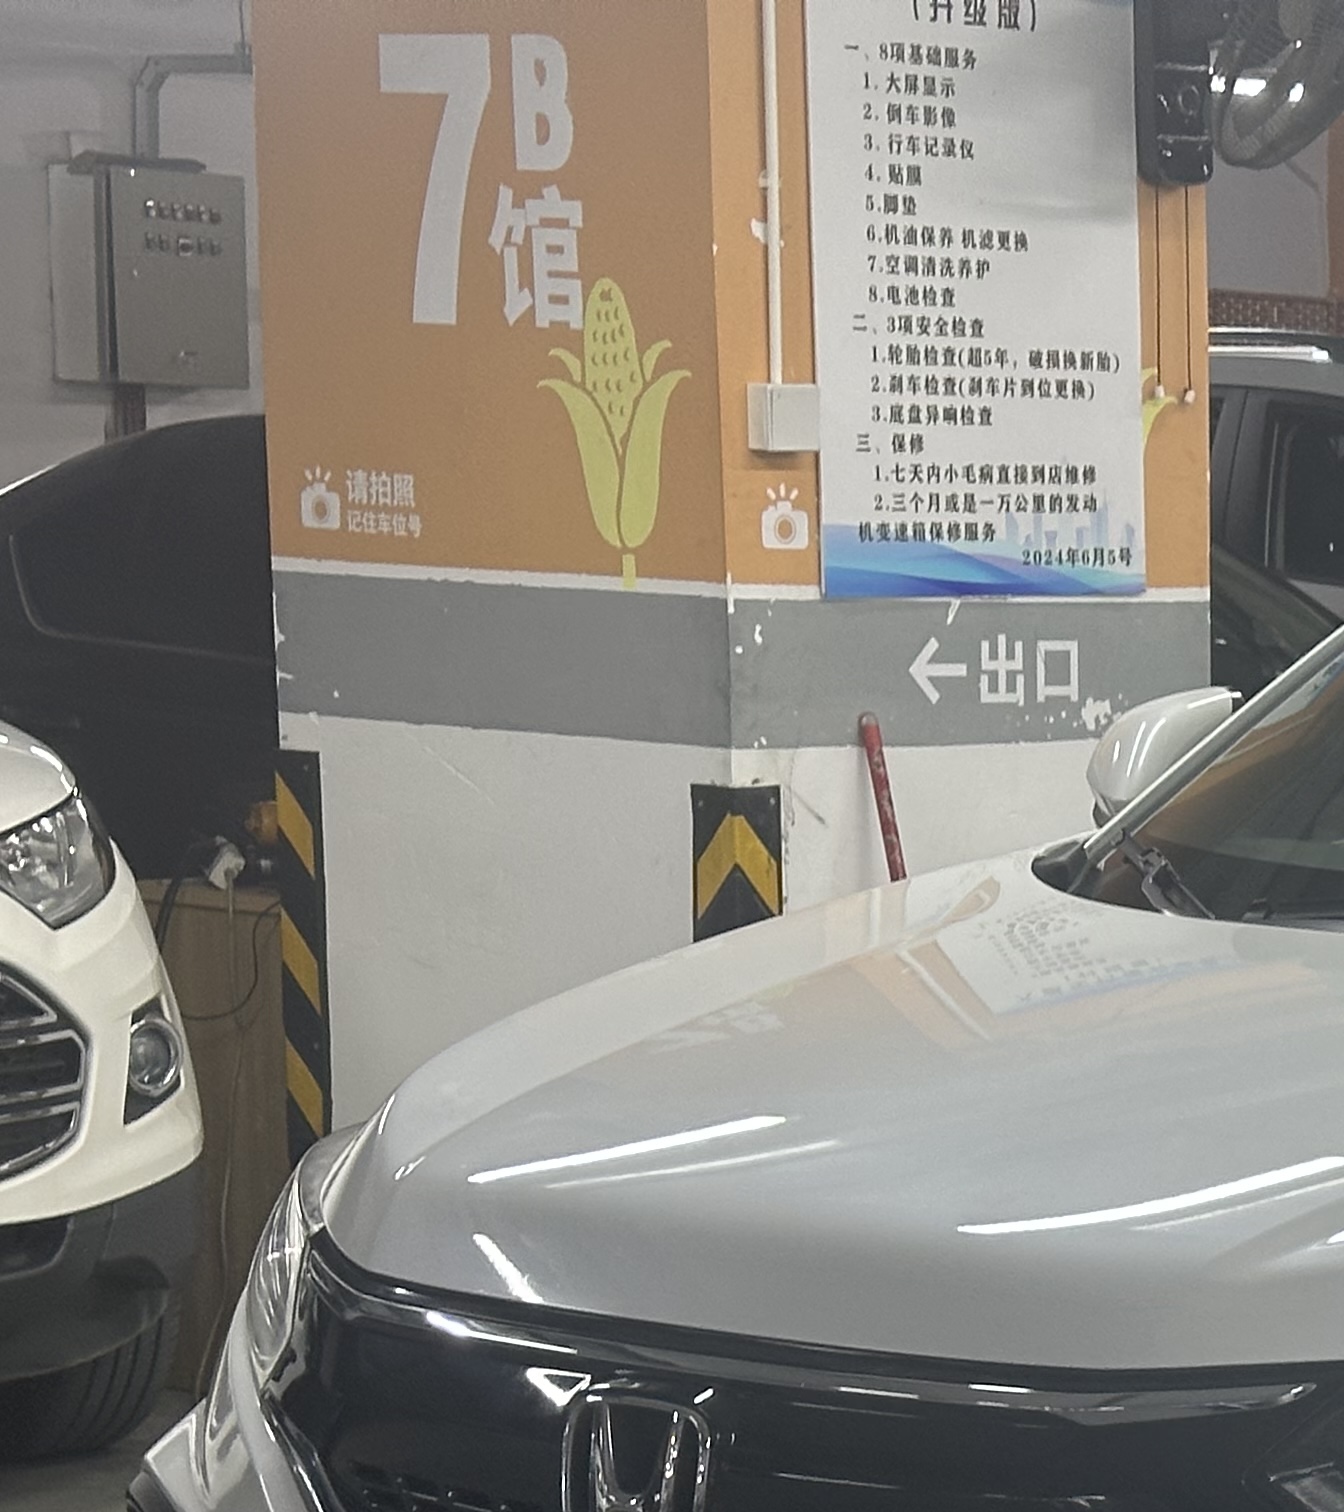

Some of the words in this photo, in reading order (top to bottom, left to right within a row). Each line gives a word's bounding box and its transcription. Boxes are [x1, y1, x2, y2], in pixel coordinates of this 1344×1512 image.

[843, 42, 978, 70] 一、8项基础服务
[866, 222, 955, 248] 6.机油保养
[867, 254, 991, 281] 7.空调清洗养护
[868, 284, 956, 308] 8.电池检查
[851, 314, 986, 339] 二、3项安全检查
[871, 403, 994, 427] 3.底盘异响检查
[855, 432, 926, 455] 三、保修
[873, 462, 1098, 486] 1.七天内小毛病直接到店维修
[345, 468, 417, 508] 请拍照
[873, 492, 1098, 516] 2.三个月或是一万公里的发动
[346, 509, 423, 539] 记住车位号
[858, 519, 997, 544] 机变速箱保修服务
[1021, 546, 1133, 569] 2024年6月5号
[979, 633, 1080, 707] 出口
